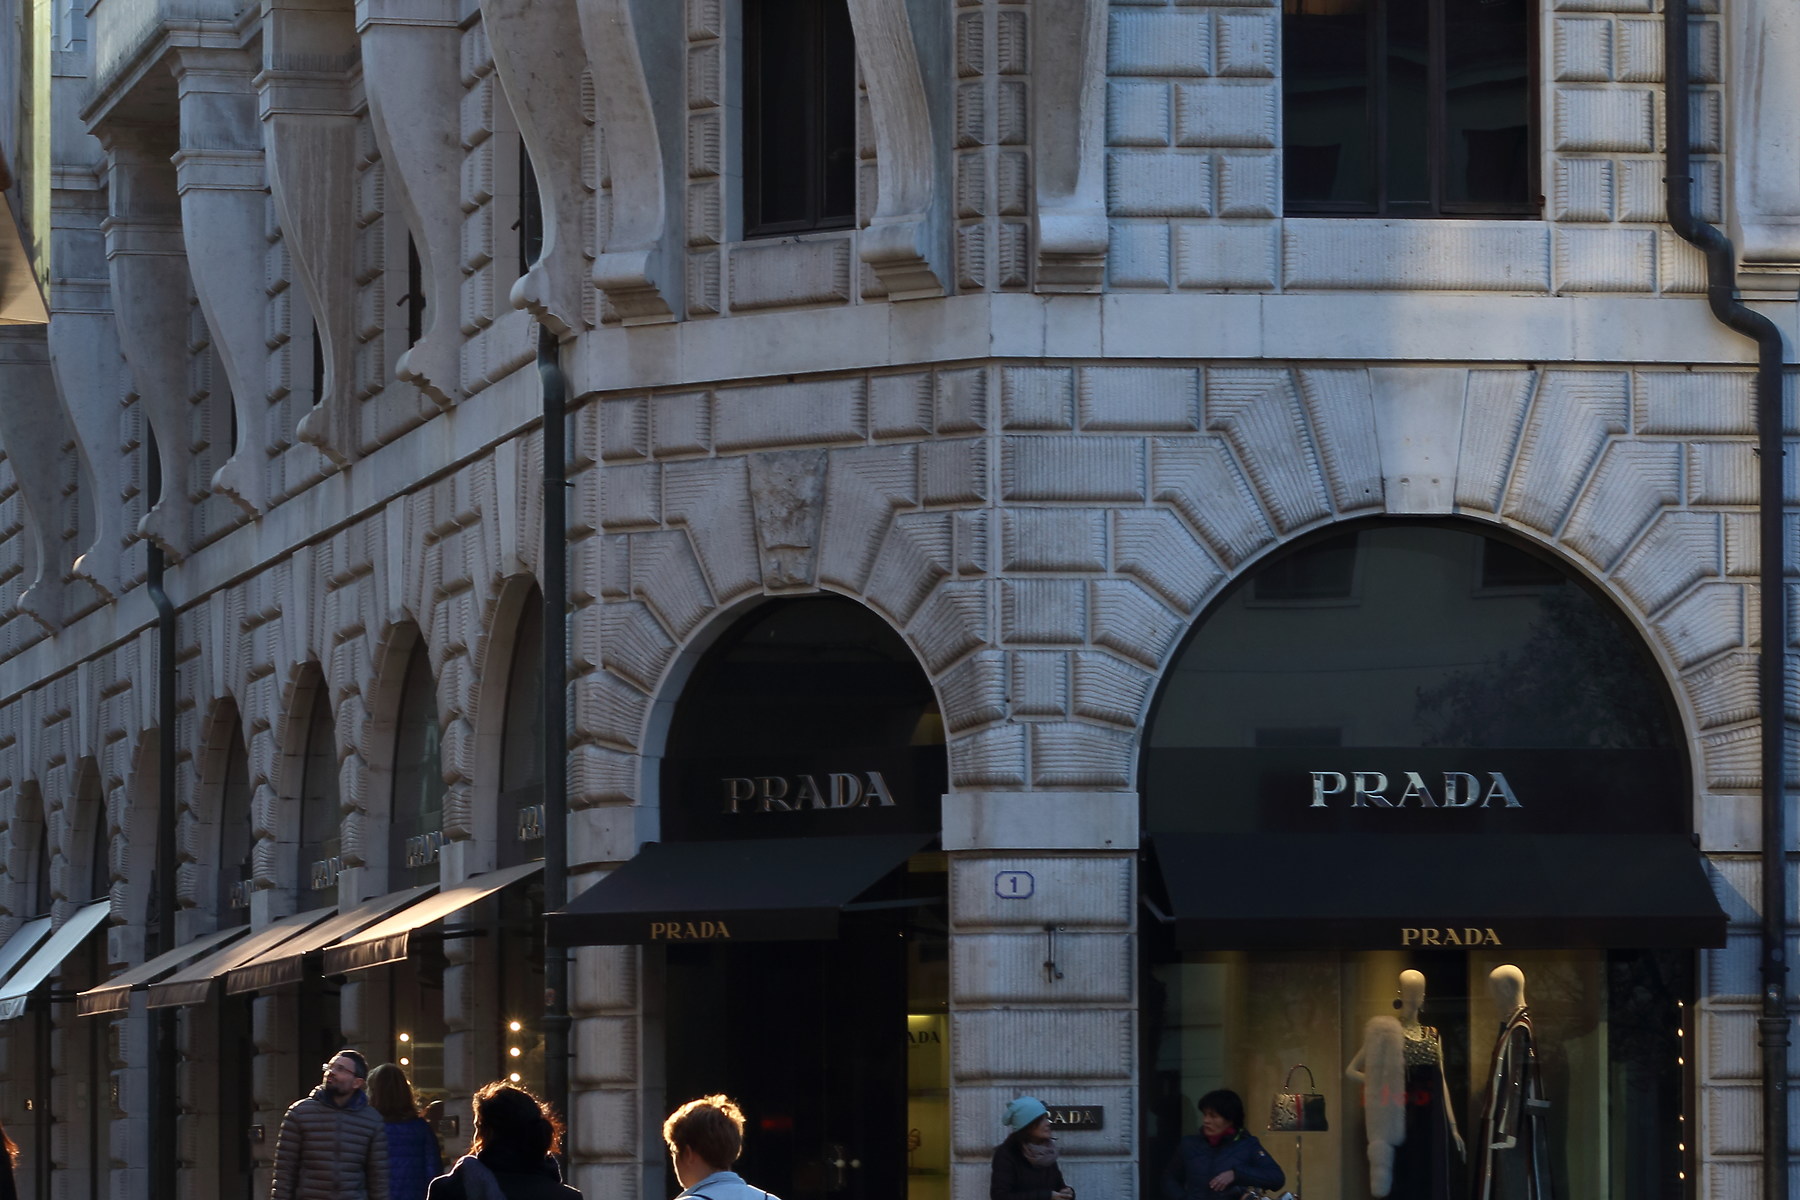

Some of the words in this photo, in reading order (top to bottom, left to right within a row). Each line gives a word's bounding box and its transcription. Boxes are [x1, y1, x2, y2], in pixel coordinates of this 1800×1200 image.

[720, 771, 896, 813] PRADA
[1308, 771, 1524, 808] PRADA
[1010, 876, 1017, 893] 1
[649, 920, 732, 940] PRADA
[1401, 927, 1503, 946] PRADA
[906, 1031, 941, 1044] ADA
[1046, 1110, 1097, 1124] RADA
